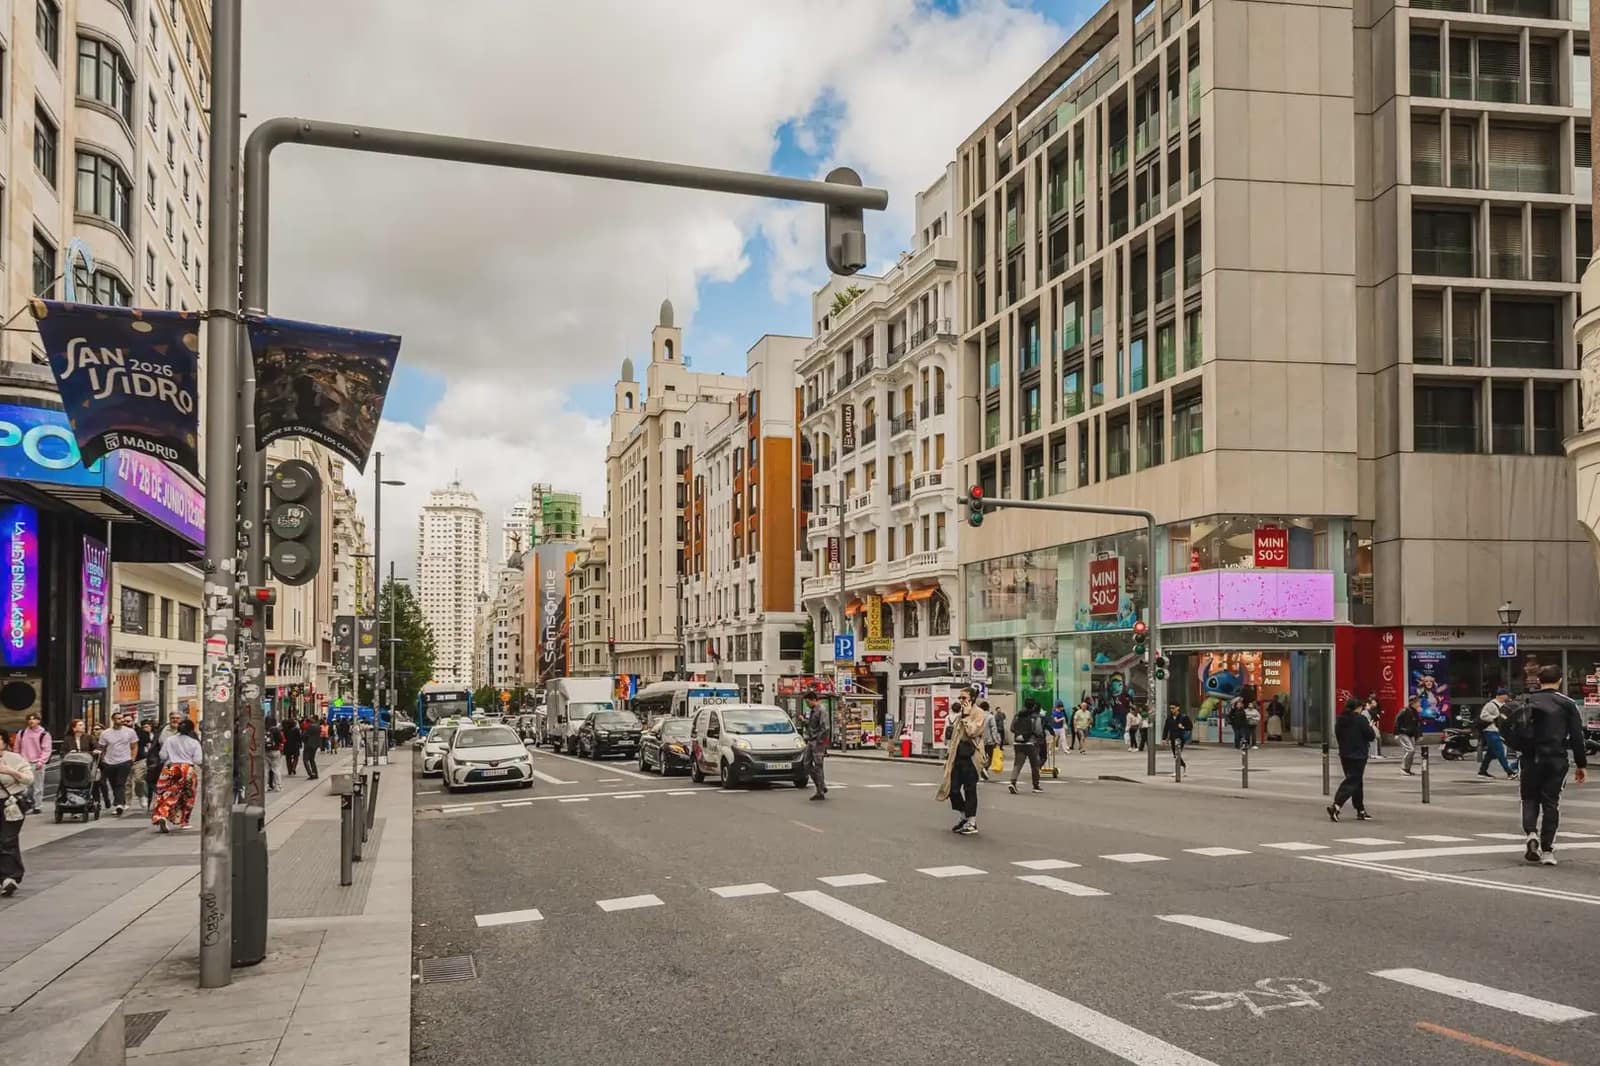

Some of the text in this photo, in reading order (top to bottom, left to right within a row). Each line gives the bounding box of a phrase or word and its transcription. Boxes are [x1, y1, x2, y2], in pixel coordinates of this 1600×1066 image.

[60, 337, 125, 380] SAN
[129, 359, 173, 376] 2026
[89, 367, 193, 415] ISIDRO
[293, 425, 322, 439] CRUZAN
[323, 435, 336, 445] LOS
[123, 435, 178, 460] MADRID
[131, 457, 138, 487] Y
[139, 464, 151, 496] 28
[151, 472, 162, 504] DE
[15, 521, 26, 537] LA
[1258, 537, 1284, 548] MINI
[1091, 570, 1116, 588] MINI
[544, 569, 557, 662] Samsonite
[840, 639, 851, 656] P
[1263, 659, 1281, 667] Blind
[1265, 668, 1279, 676] Box
[703, 697, 728, 705] BOOK
